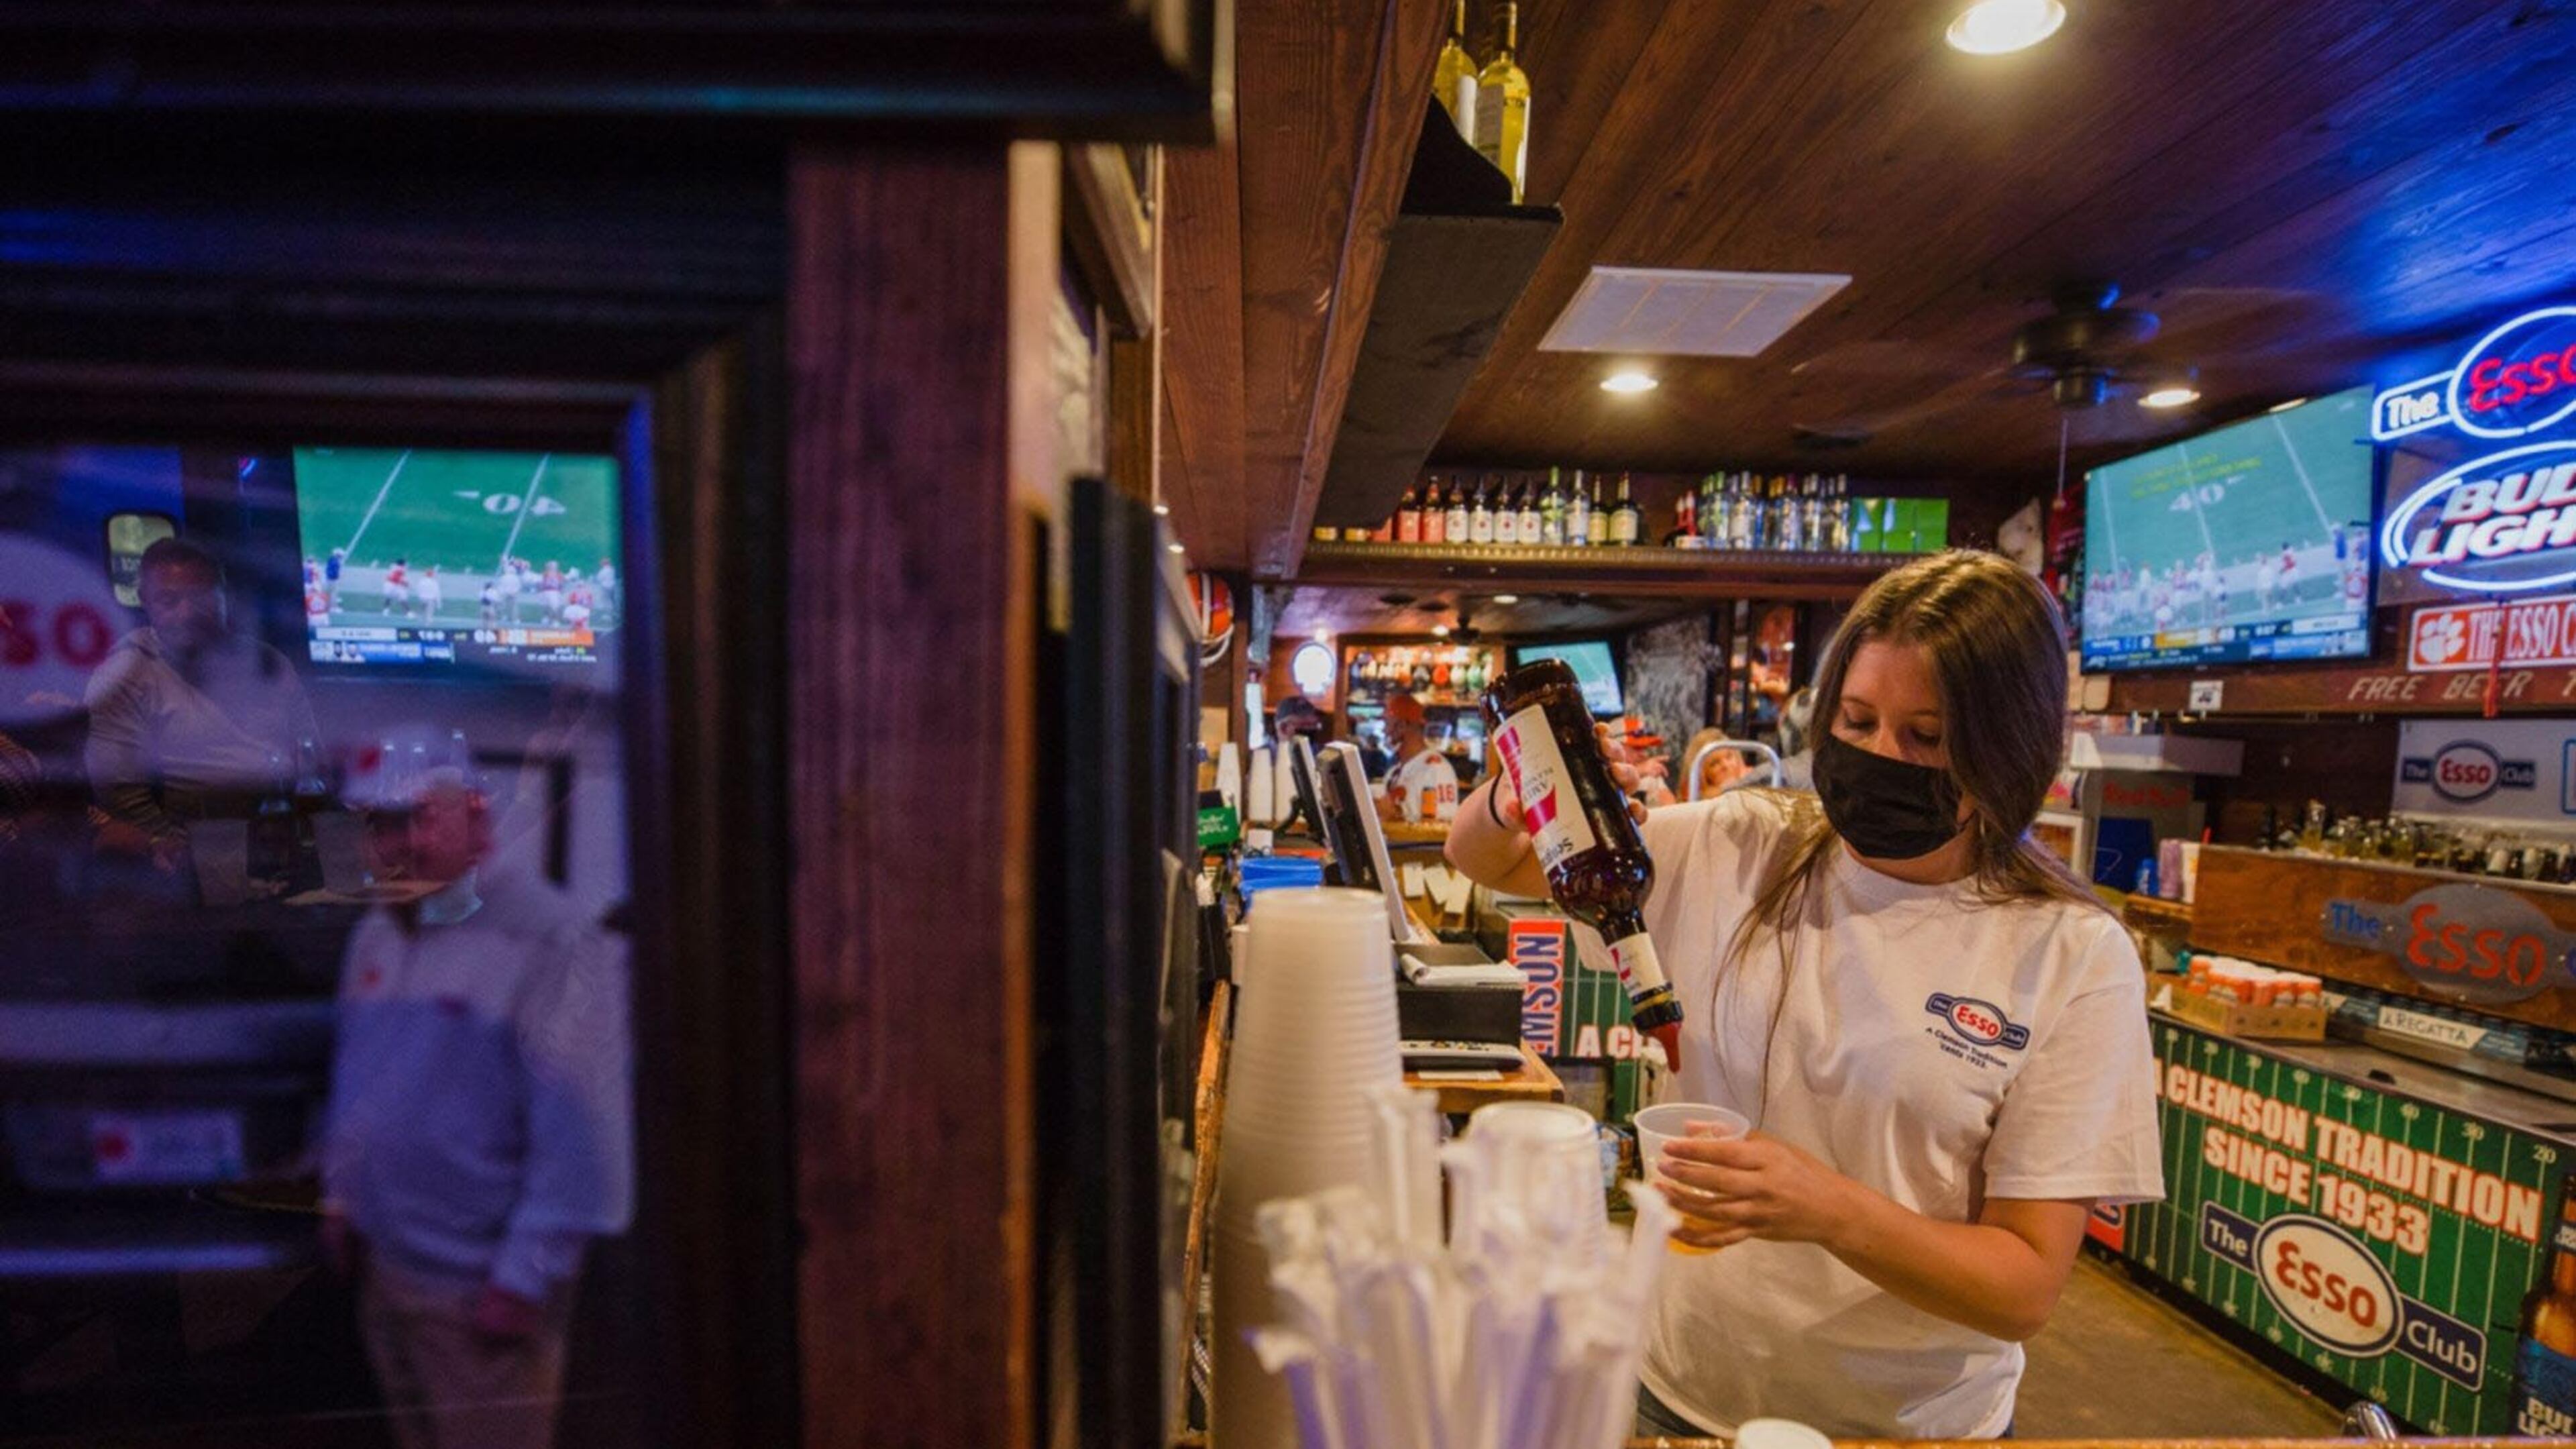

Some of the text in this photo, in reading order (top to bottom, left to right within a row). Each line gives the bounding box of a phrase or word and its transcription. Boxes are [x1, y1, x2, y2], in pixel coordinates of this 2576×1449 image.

[2386, 390, 2440, 429] The
[2506, 604, 2559, 659] ESSO
[2349, 674, 2425, 700] FREE
[2442, 671, 2534, 699] BER
[2330, 902, 2381, 938] The
[1517, 935, 1560, 1058] EMSON
[1576, 1024, 1603, 1059] A
[2396, 1012, 2469, 1042] REGATTA
[2167, 1063, 2544, 1246] CLEMSON TRADITION
[2203, 1125, 2430, 1256] SINCE 1933
[2209, 1219, 2248, 1258] The
[2406, 1320, 2477, 1375] Club
